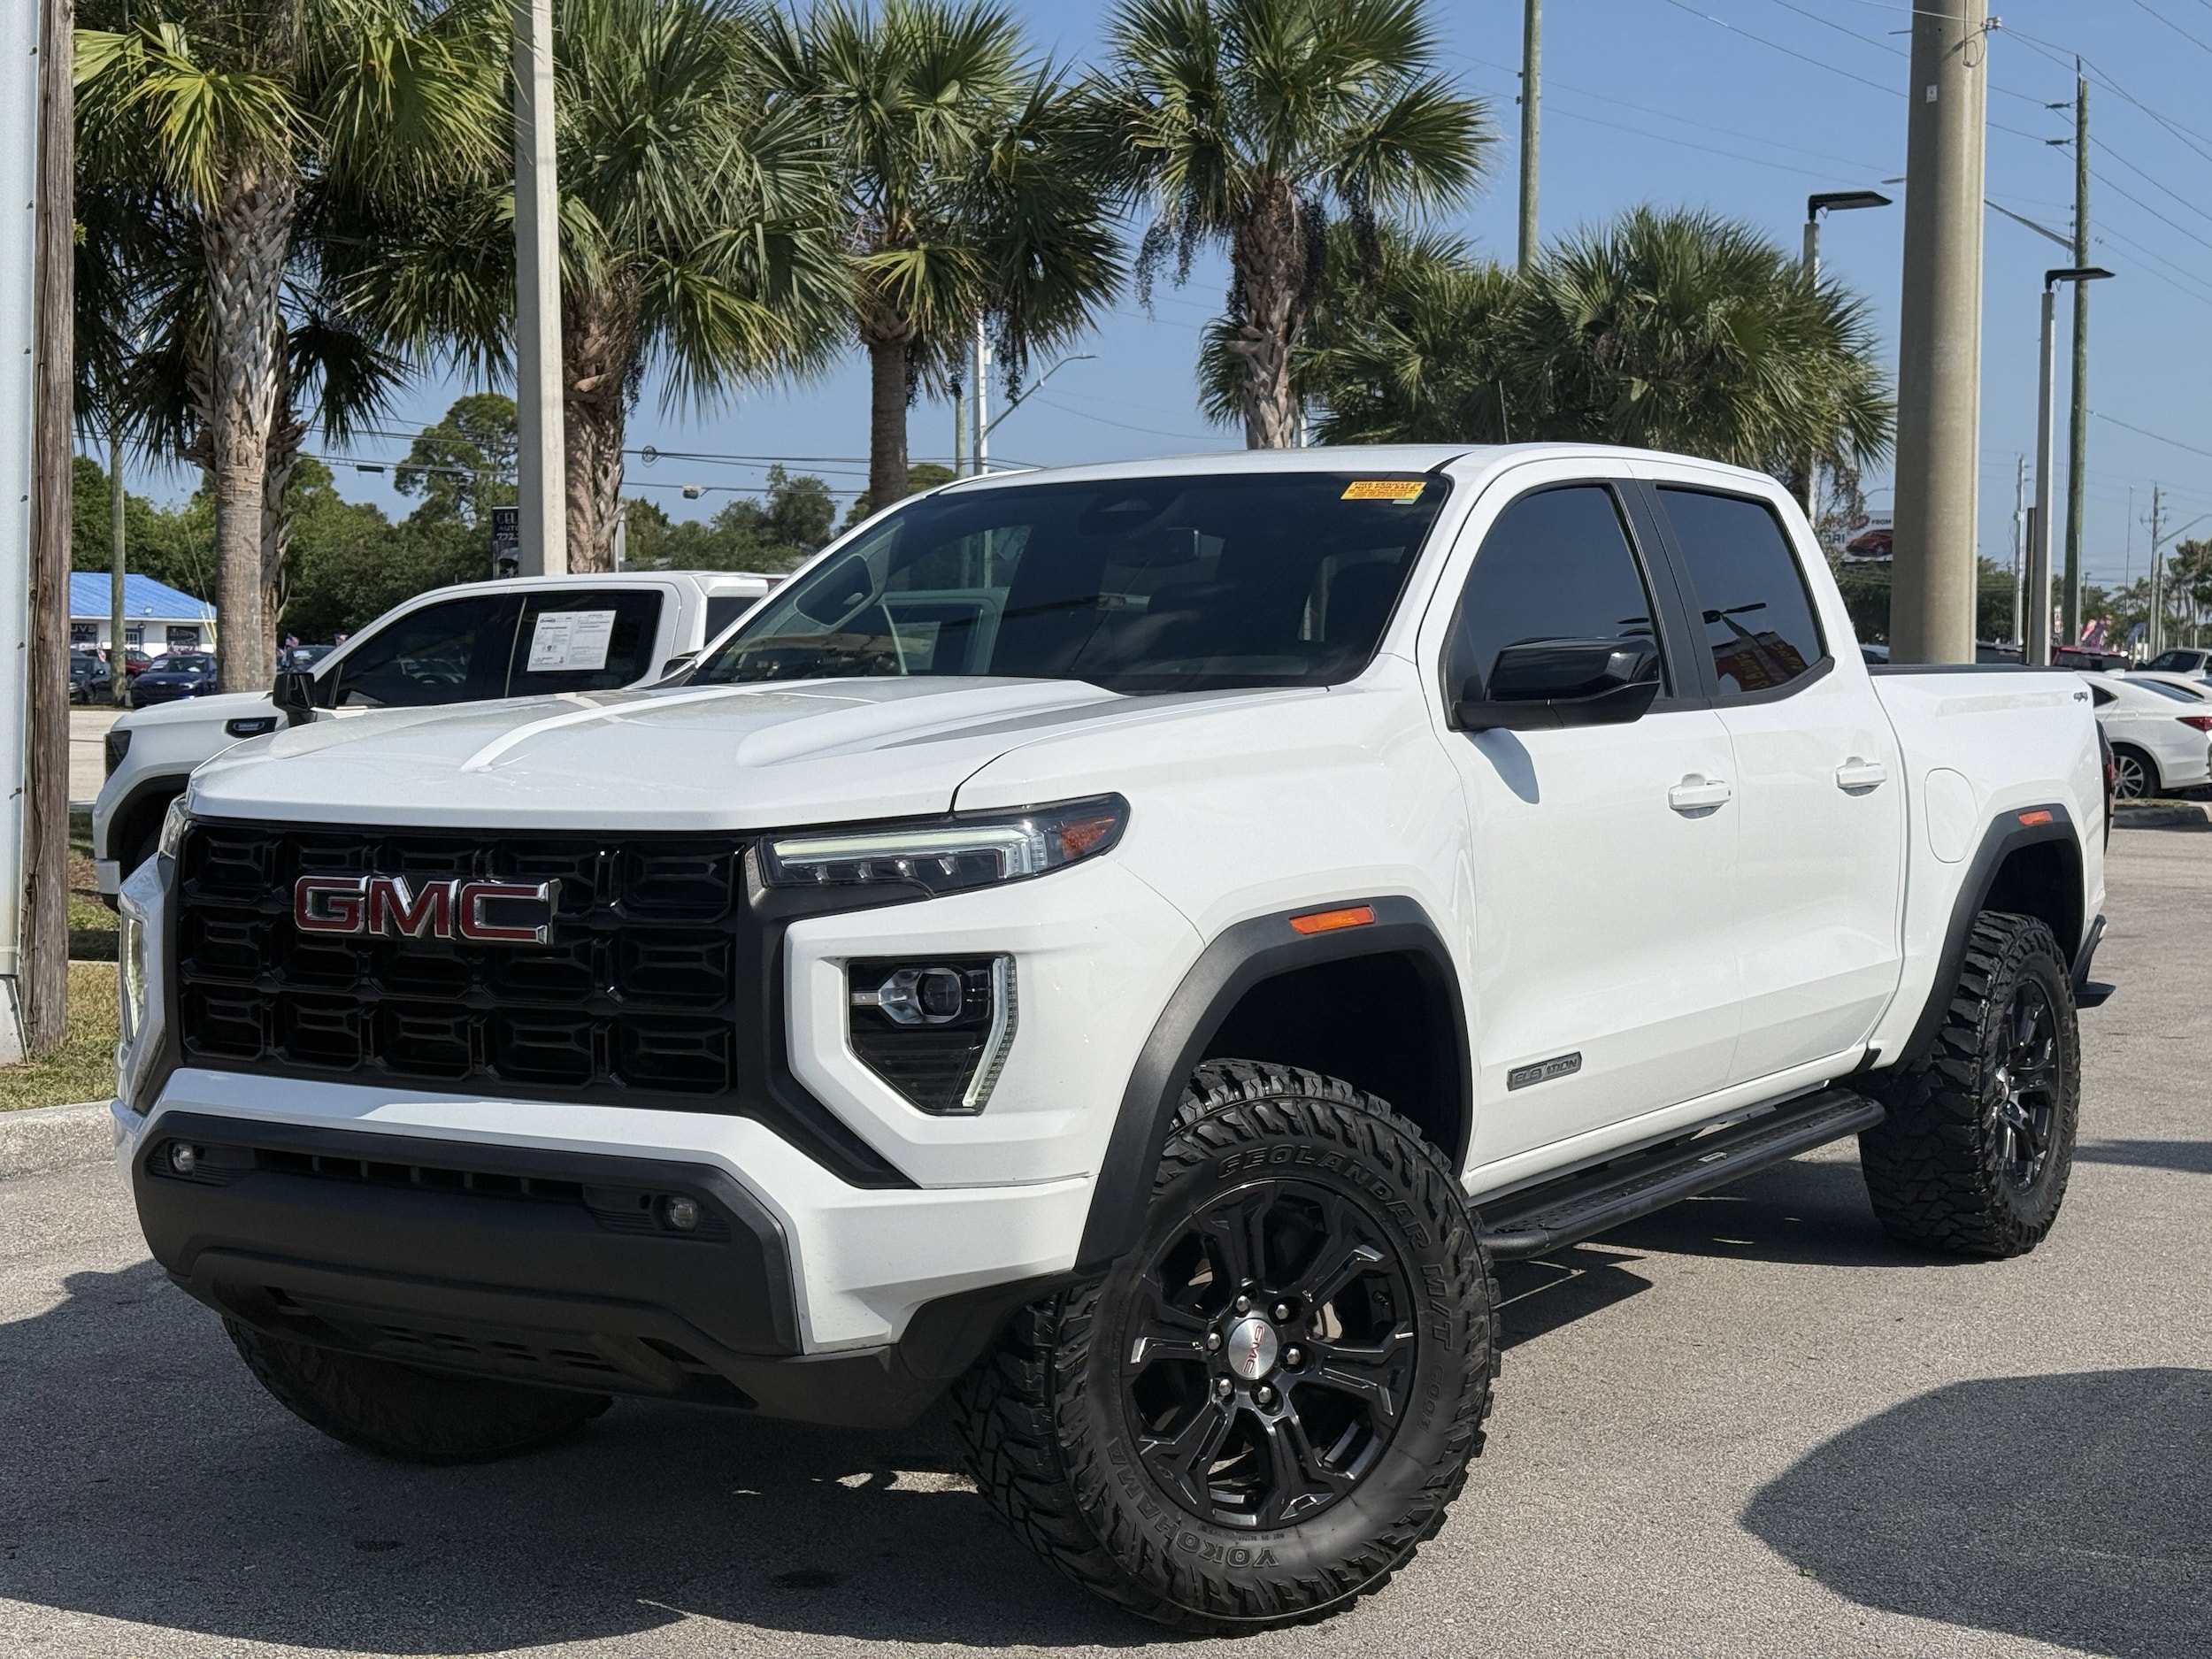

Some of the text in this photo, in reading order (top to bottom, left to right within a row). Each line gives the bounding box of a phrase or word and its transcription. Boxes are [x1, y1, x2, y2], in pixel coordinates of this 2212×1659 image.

[294, 874, 553, 945] GMC
[1218, 1143, 1453, 1351] GEOLANDAR M/T
[1241, 1325, 1266, 1374] GMC
[1106, 1437, 1280, 1568] YOKOHAMA
